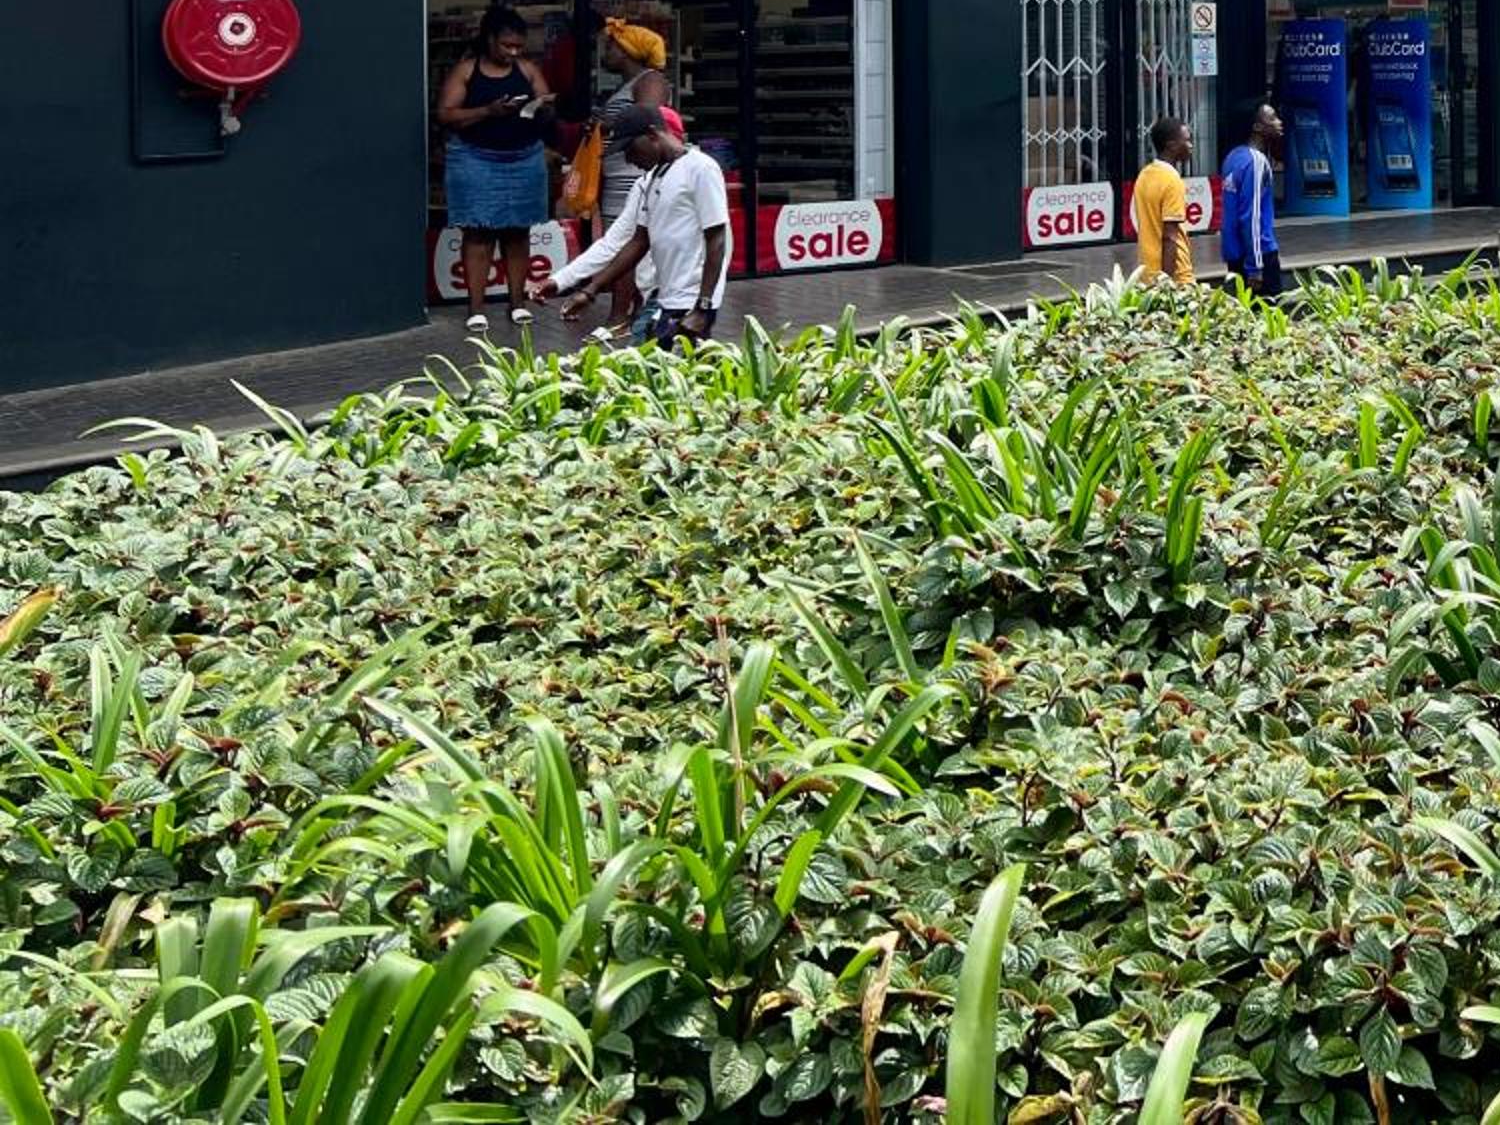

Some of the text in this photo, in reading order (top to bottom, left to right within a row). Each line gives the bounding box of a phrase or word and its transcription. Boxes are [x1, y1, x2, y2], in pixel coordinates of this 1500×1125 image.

[1037, 189, 1107, 208] clearance
[787, 209, 871, 227] clearance
[1037, 204, 1106, 238] sale
[788, 224, 870, 261] sale
